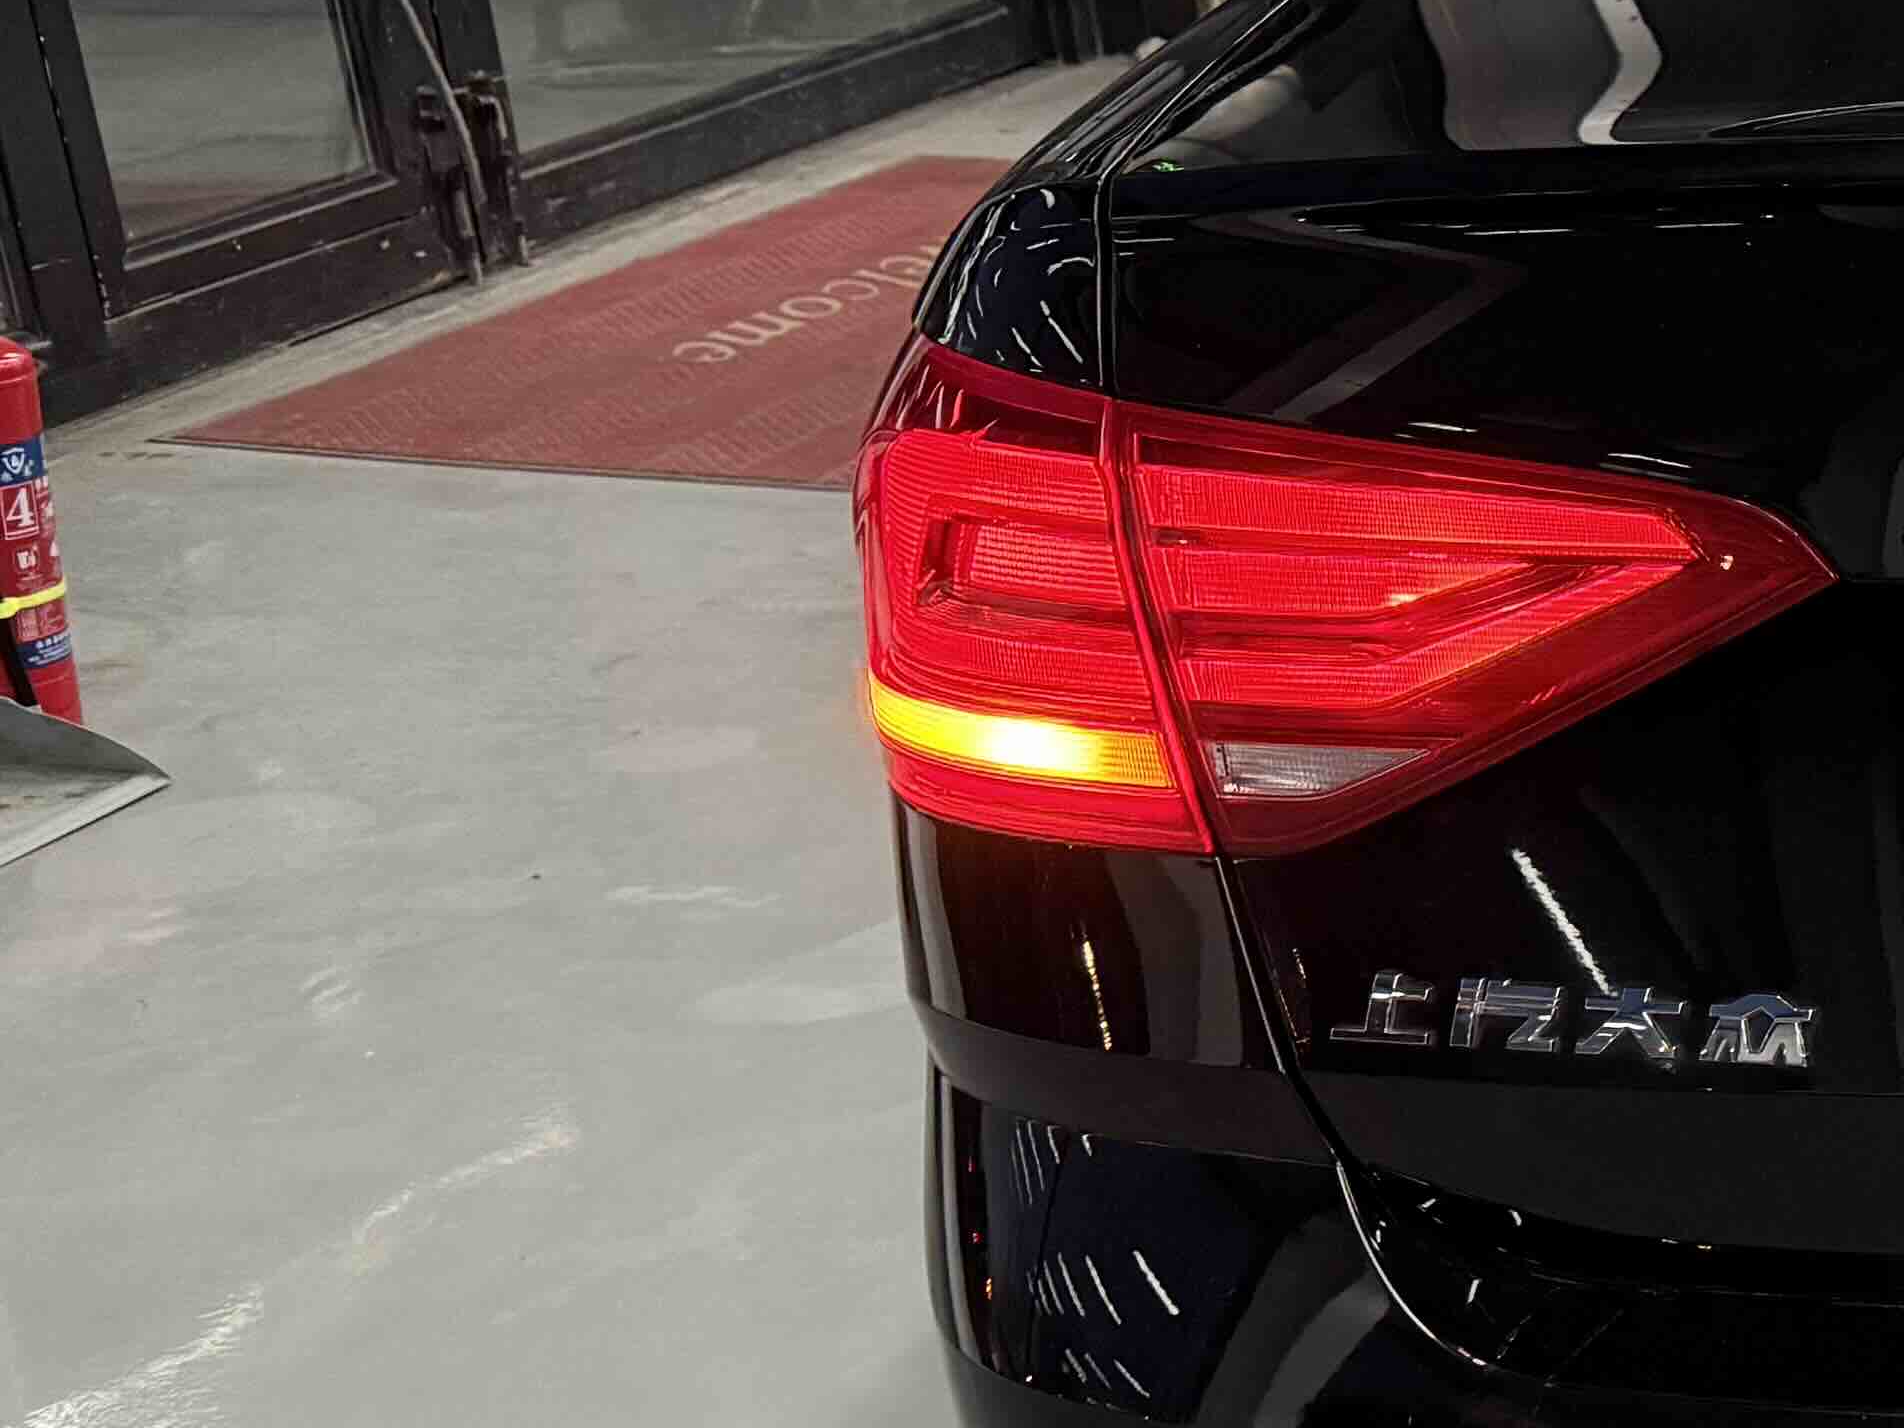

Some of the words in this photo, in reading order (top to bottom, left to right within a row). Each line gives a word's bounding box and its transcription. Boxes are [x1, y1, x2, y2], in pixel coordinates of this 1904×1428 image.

[672, 237, 945, 363] elcome
[6, 486, 36, 527] 4
[1328, 972, 1816, 1069] 上汽大众
